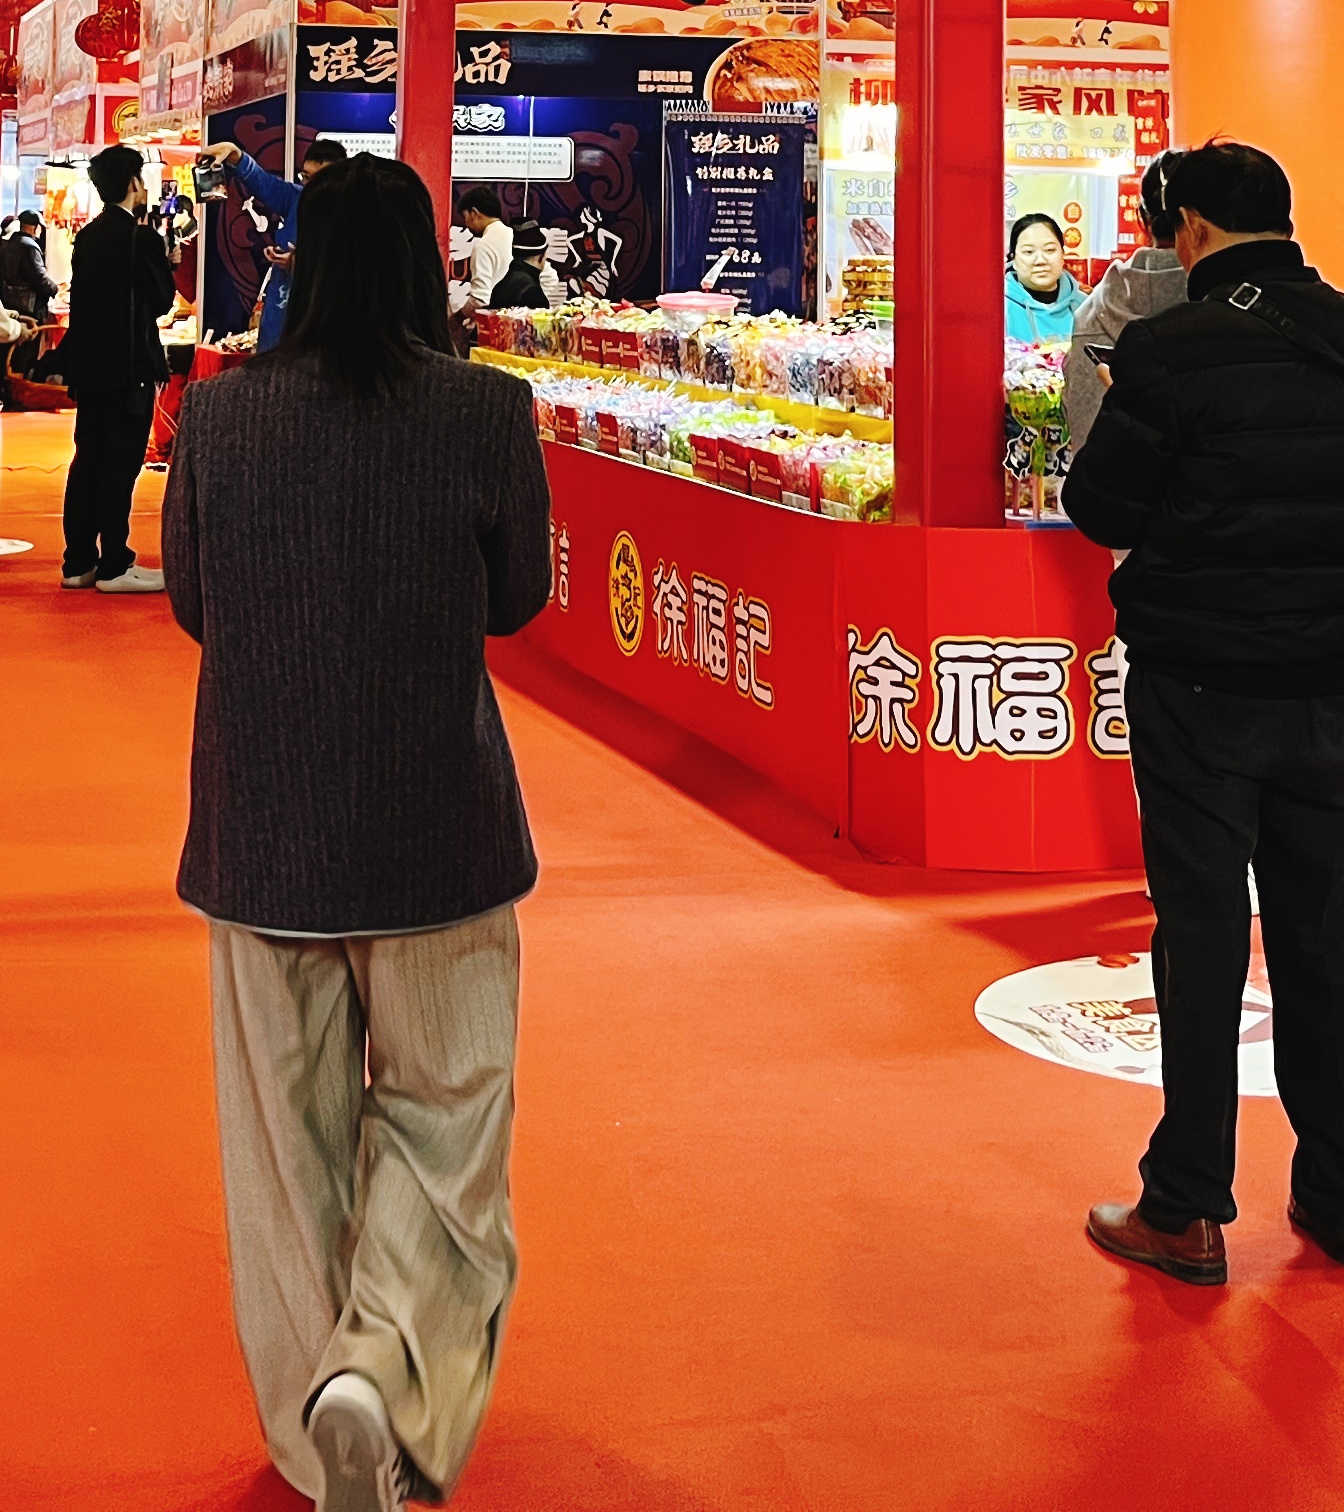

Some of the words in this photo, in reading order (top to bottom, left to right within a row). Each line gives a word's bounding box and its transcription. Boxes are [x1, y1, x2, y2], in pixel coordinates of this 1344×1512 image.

[307, 36, 511, 85] 瑶乡品
[652, 559, 774, 709] 徐福記
